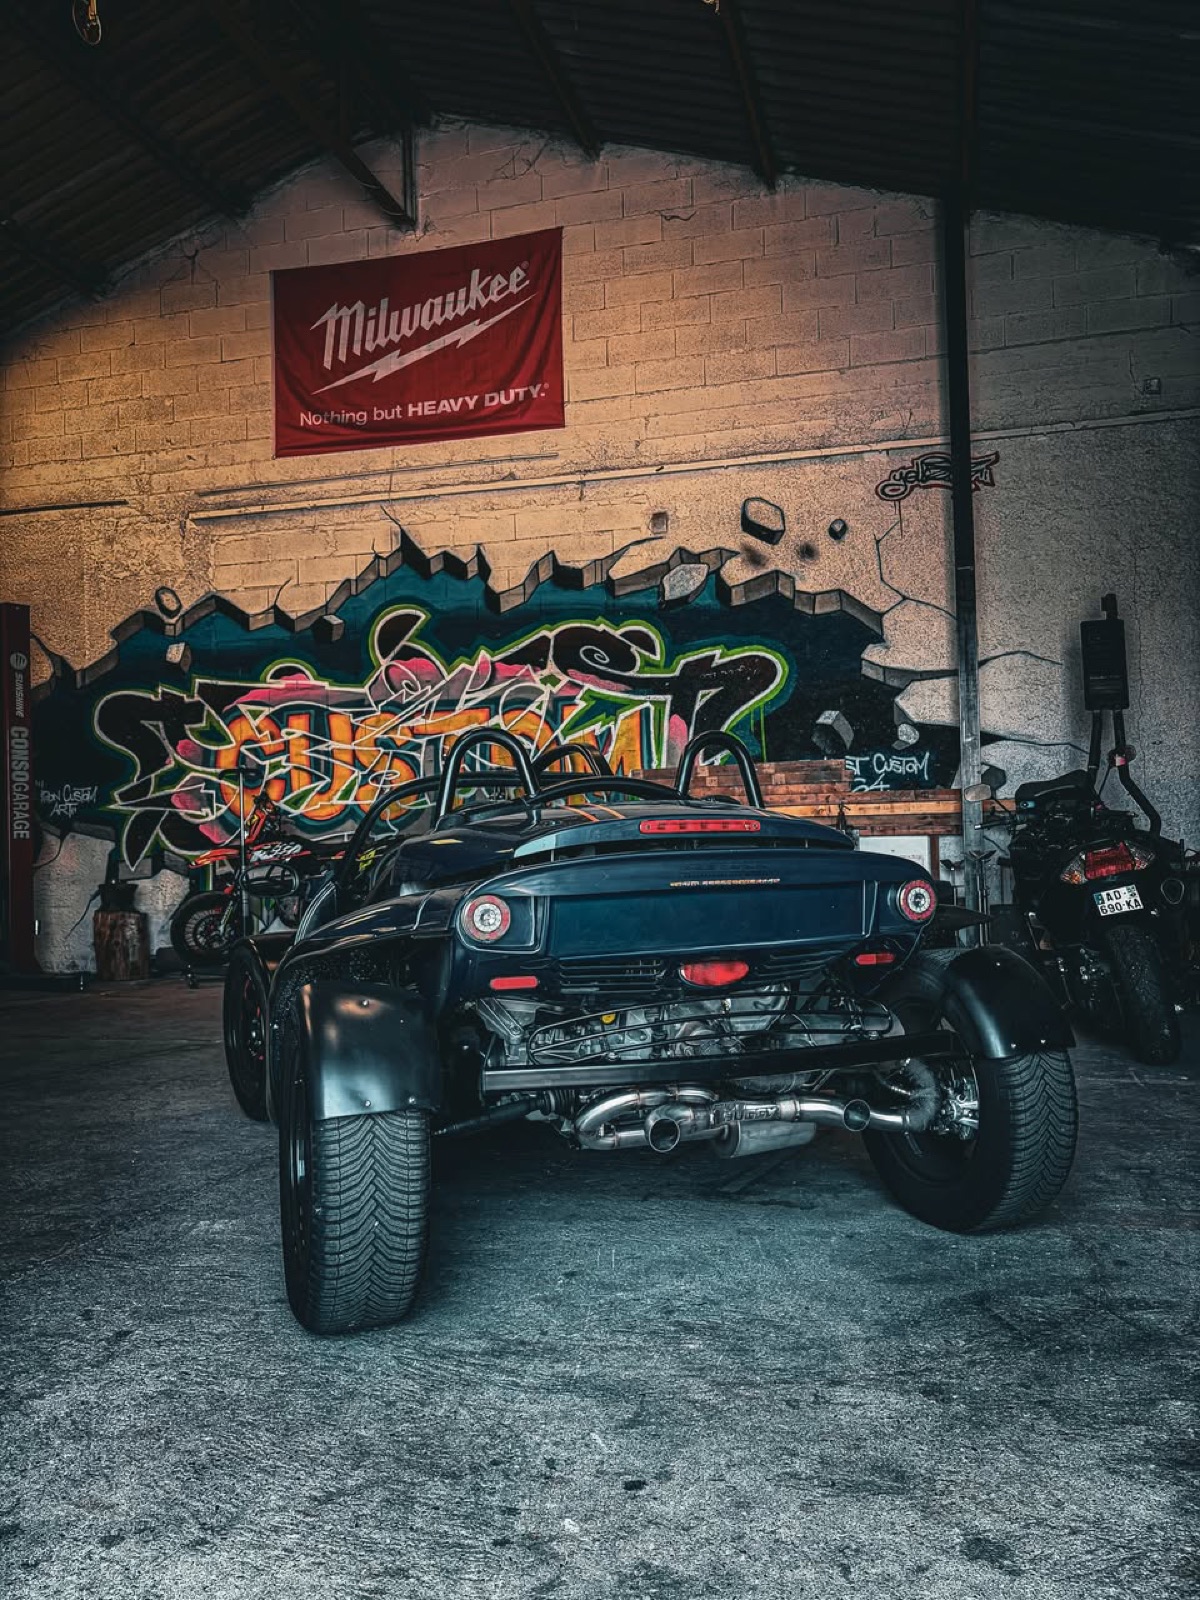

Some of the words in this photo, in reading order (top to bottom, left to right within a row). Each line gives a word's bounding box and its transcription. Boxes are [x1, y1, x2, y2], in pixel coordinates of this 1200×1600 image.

[310, 263, 530, 371] Milwaukee
[300, 410, 368, 426] Nothing
[373, 405, 402, 421] but
[407, 394, 479, 417] HEAVY
[15, 672, 25, 718] SUNSHINE
[10, 726, 31, 840] CONSOGARAGE
[1099, 898, 1141, 915] 690-KA
